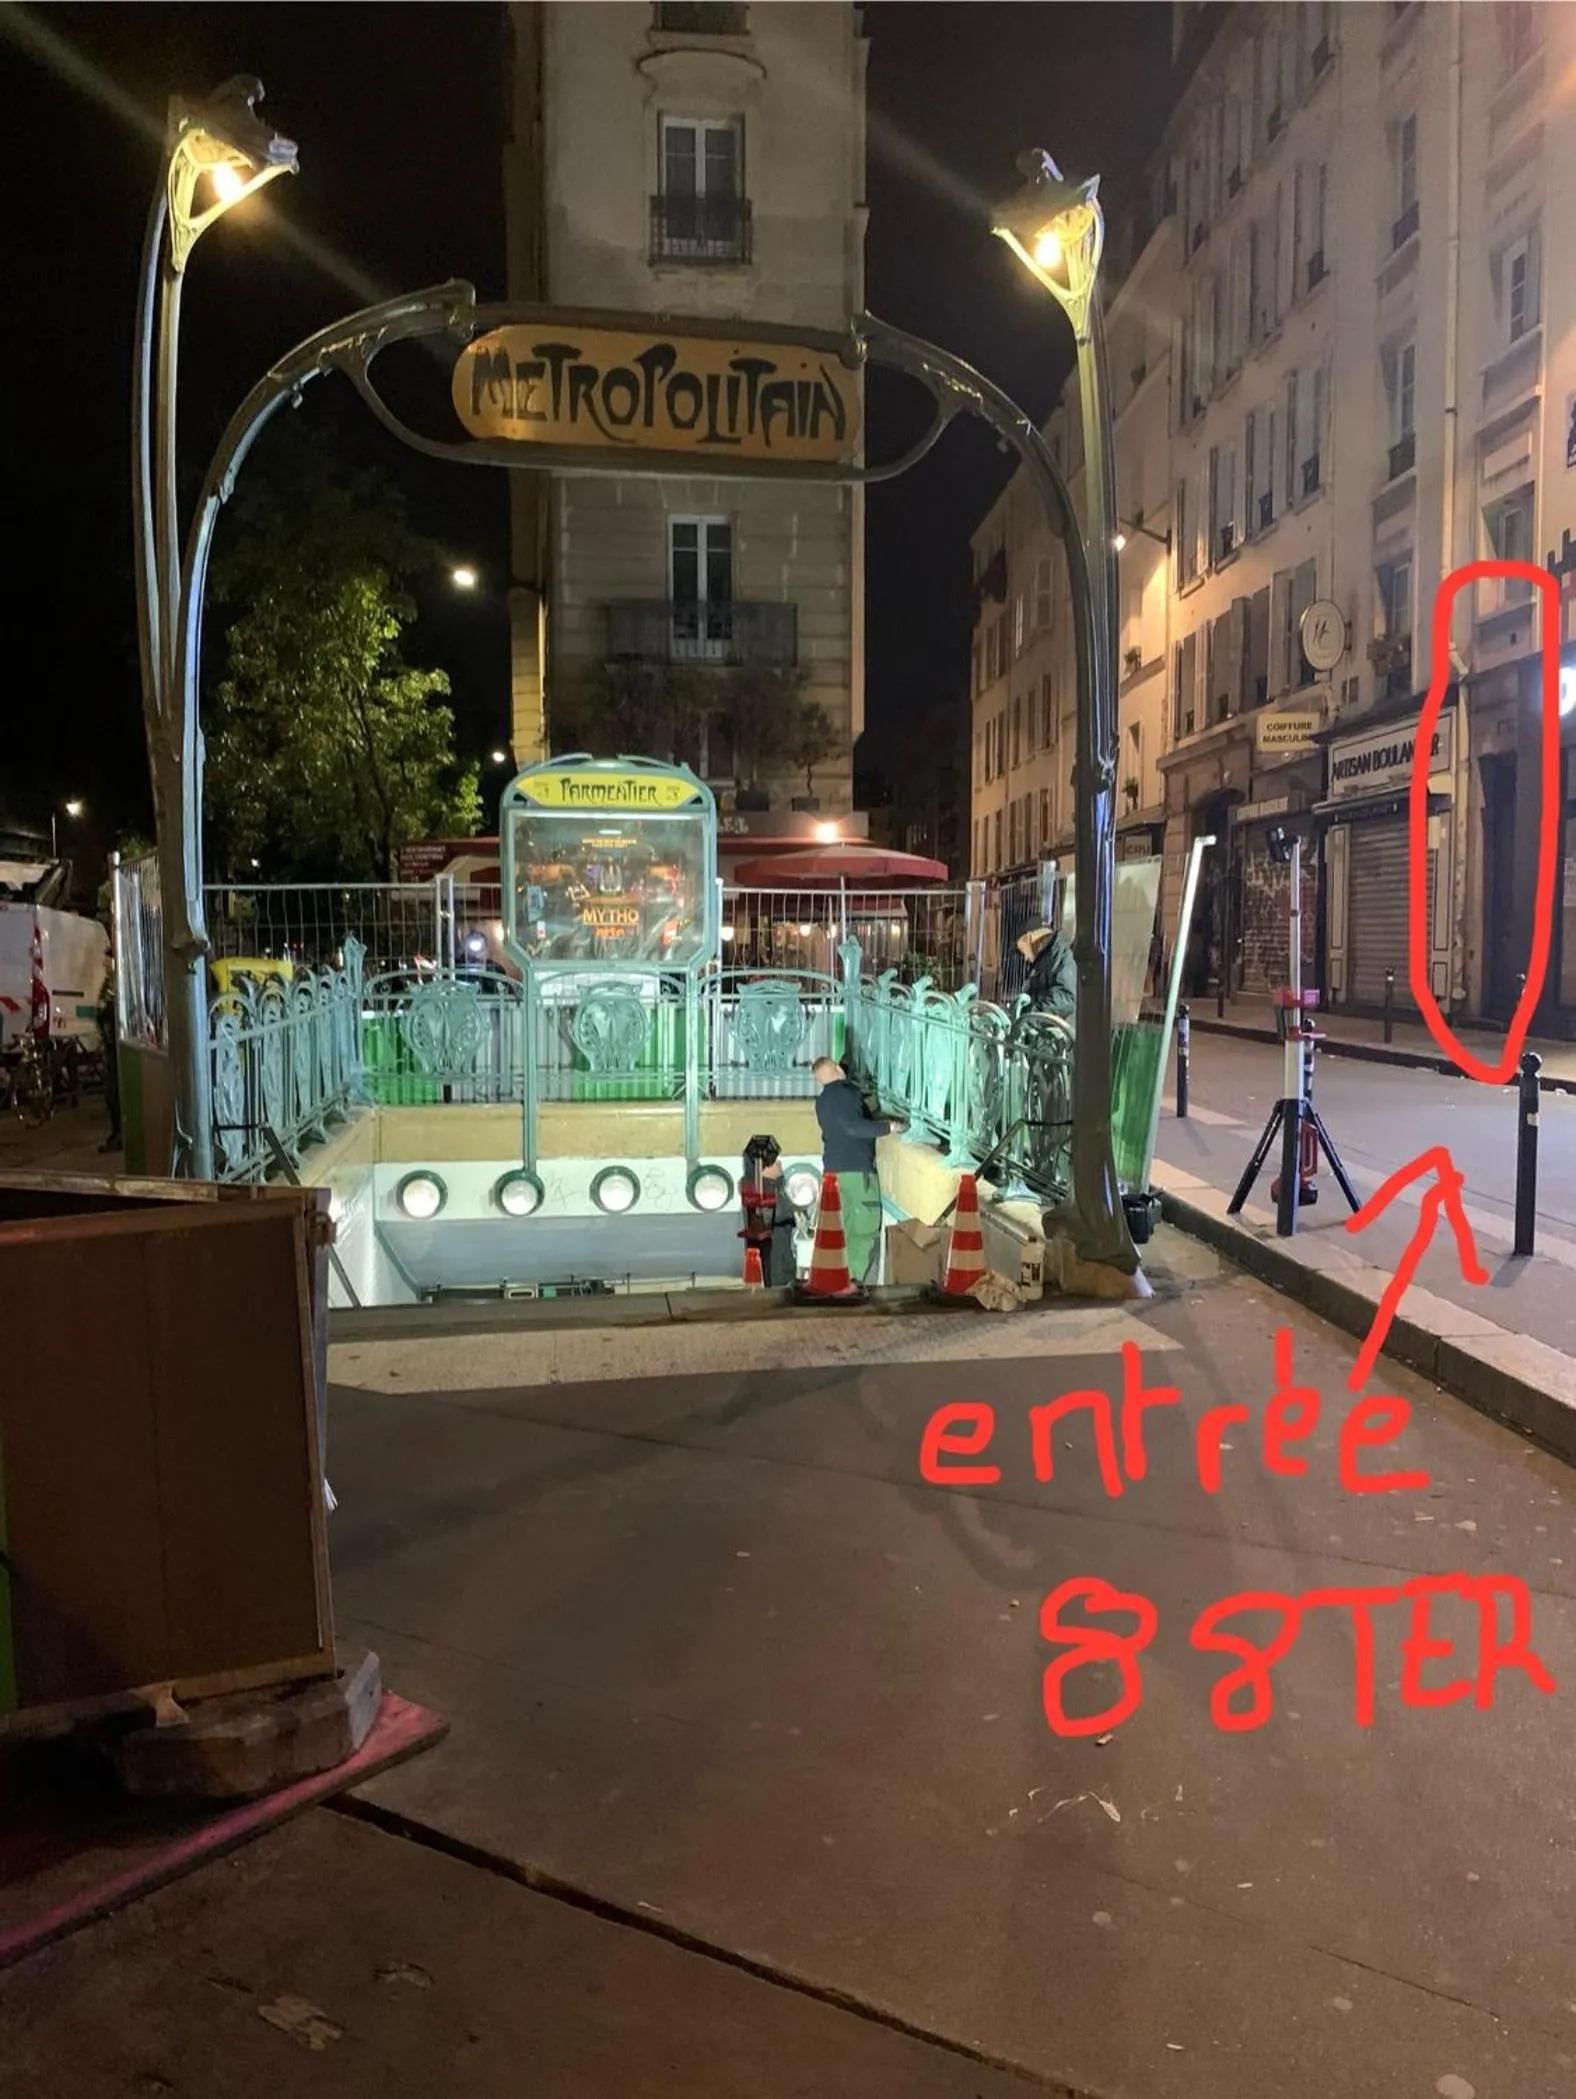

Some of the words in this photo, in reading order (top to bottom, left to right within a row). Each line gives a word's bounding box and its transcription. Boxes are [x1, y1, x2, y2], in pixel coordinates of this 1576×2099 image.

[1266, 721, 1313, 732] COIFFURE
[1331, 751, 1372, 782] ARTISAN
[560, 777, 663, 806] PARMENTIER
[583, 908, 640, 923] MYTHO
